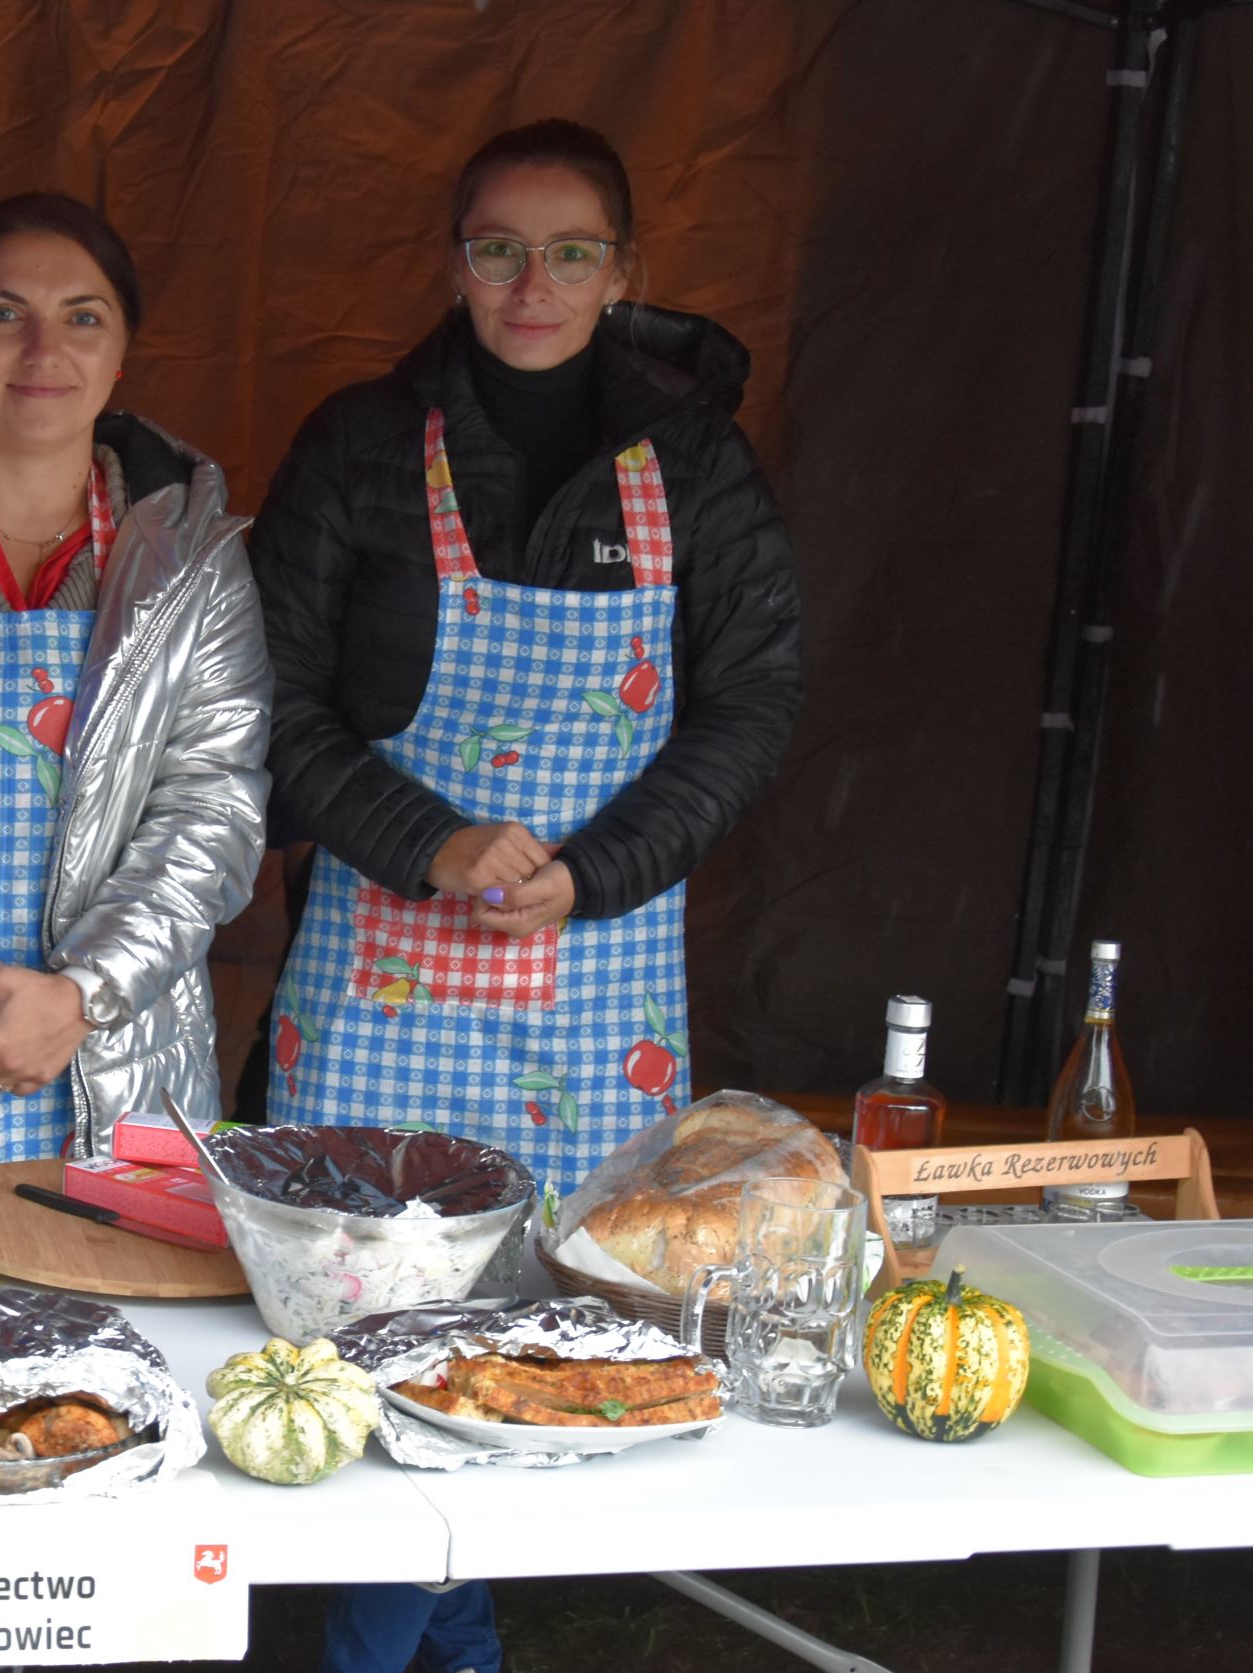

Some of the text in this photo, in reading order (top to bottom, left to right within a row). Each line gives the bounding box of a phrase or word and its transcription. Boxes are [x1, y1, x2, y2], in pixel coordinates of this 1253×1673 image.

[913, 1141, 1158, 1183] Ławka Rezerwowych
[1077, 1187, 1107, 1196] VODKA
